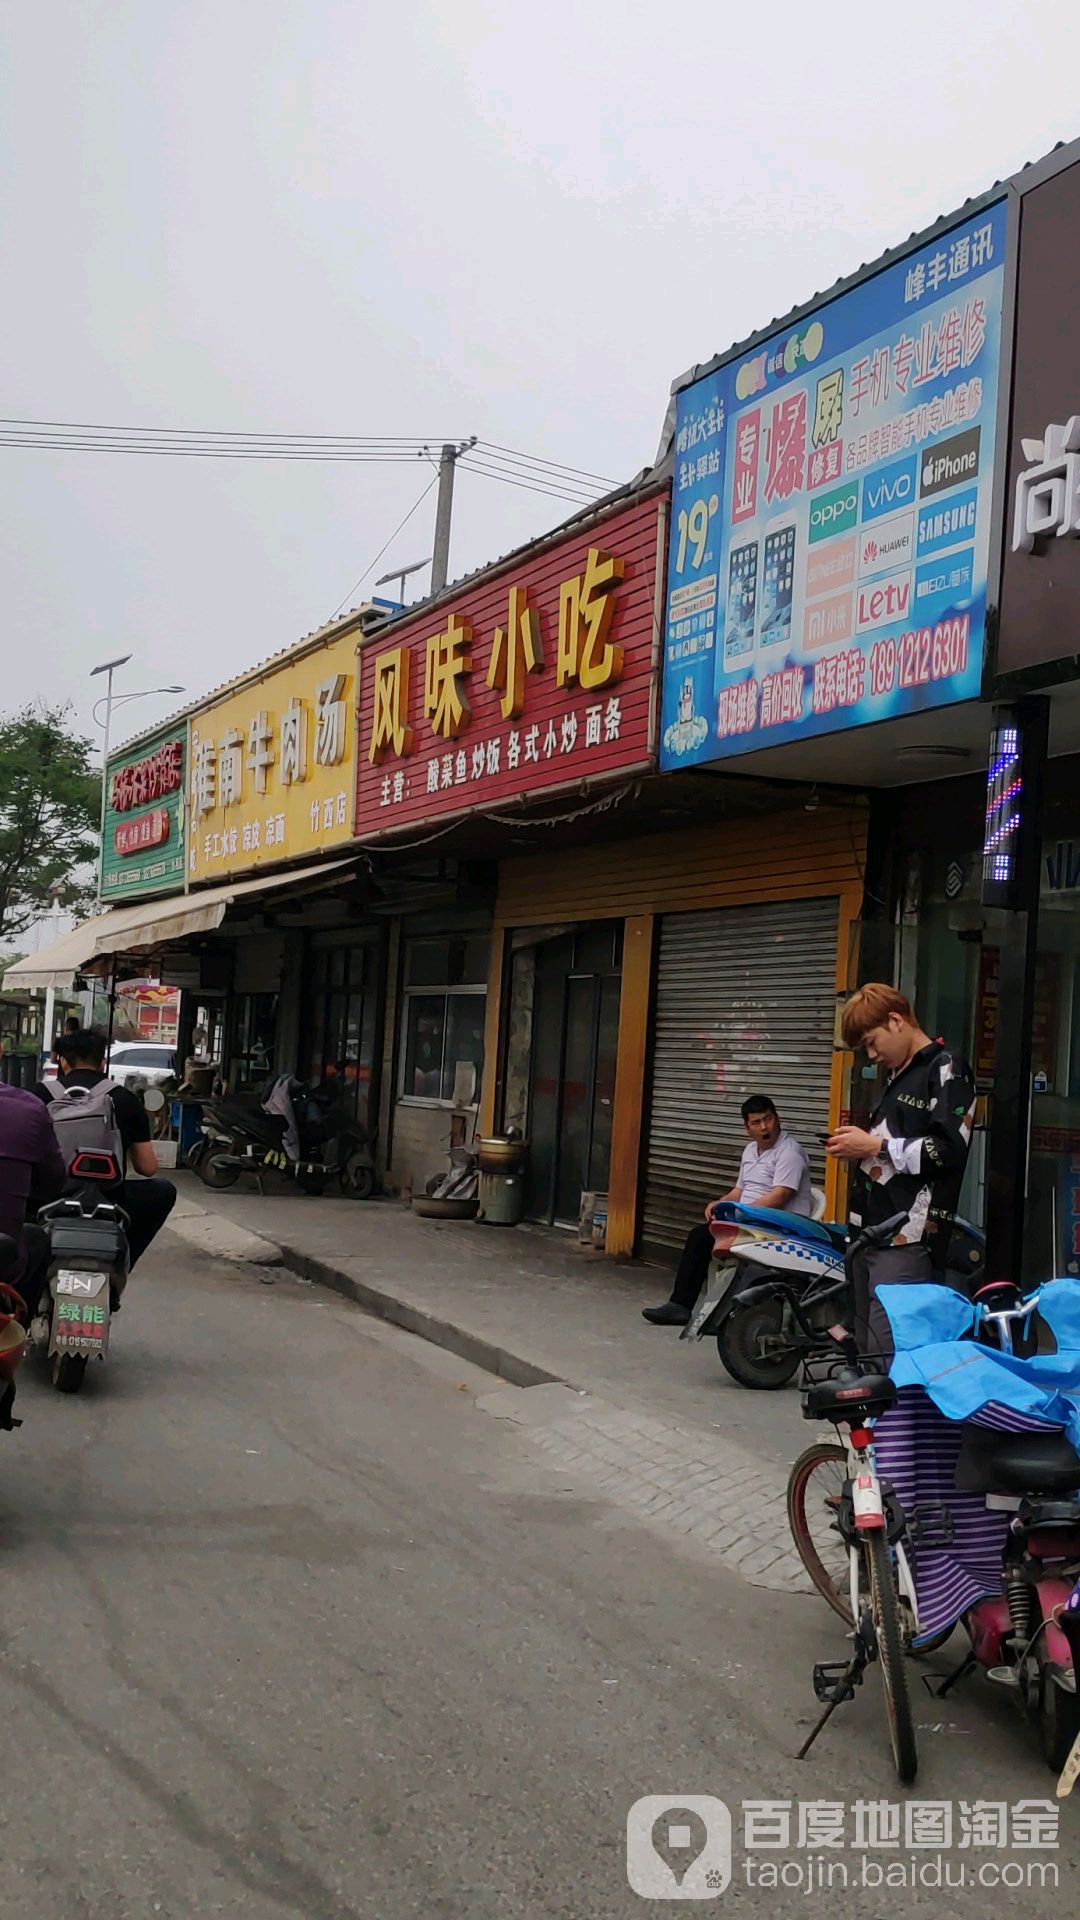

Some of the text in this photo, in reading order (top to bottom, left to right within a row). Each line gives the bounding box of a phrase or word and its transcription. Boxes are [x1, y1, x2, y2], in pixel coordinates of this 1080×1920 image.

[904, 223, 993, 303] 峰丰通讯
[850, 298, 986, 418] 手机专业维修
[846, 378, 982, 471] 各品牌智能手机专业维修
[735, 423, 757, 515] 专业
[811, 446, 839, 486] 修复
[868, 474, 911, 509] vivo
[934, 450, 976, 484] iPhone
[1012, 415, 1080, 553] 尚
[811, 496, 857, 526] oppo
[918, 501, 976, 544] SAMSUNG
[879, 536, 909, 553] HUAWEI
[859, 583, 909, 624] Letv
[368, 548, 624, 765] 风味小吃
[761, 667, 804, 727] 高价回收
[195, 673, 346, 817] 淮南牛肉汤
[58, 1303, 104, 1324] 绿能
